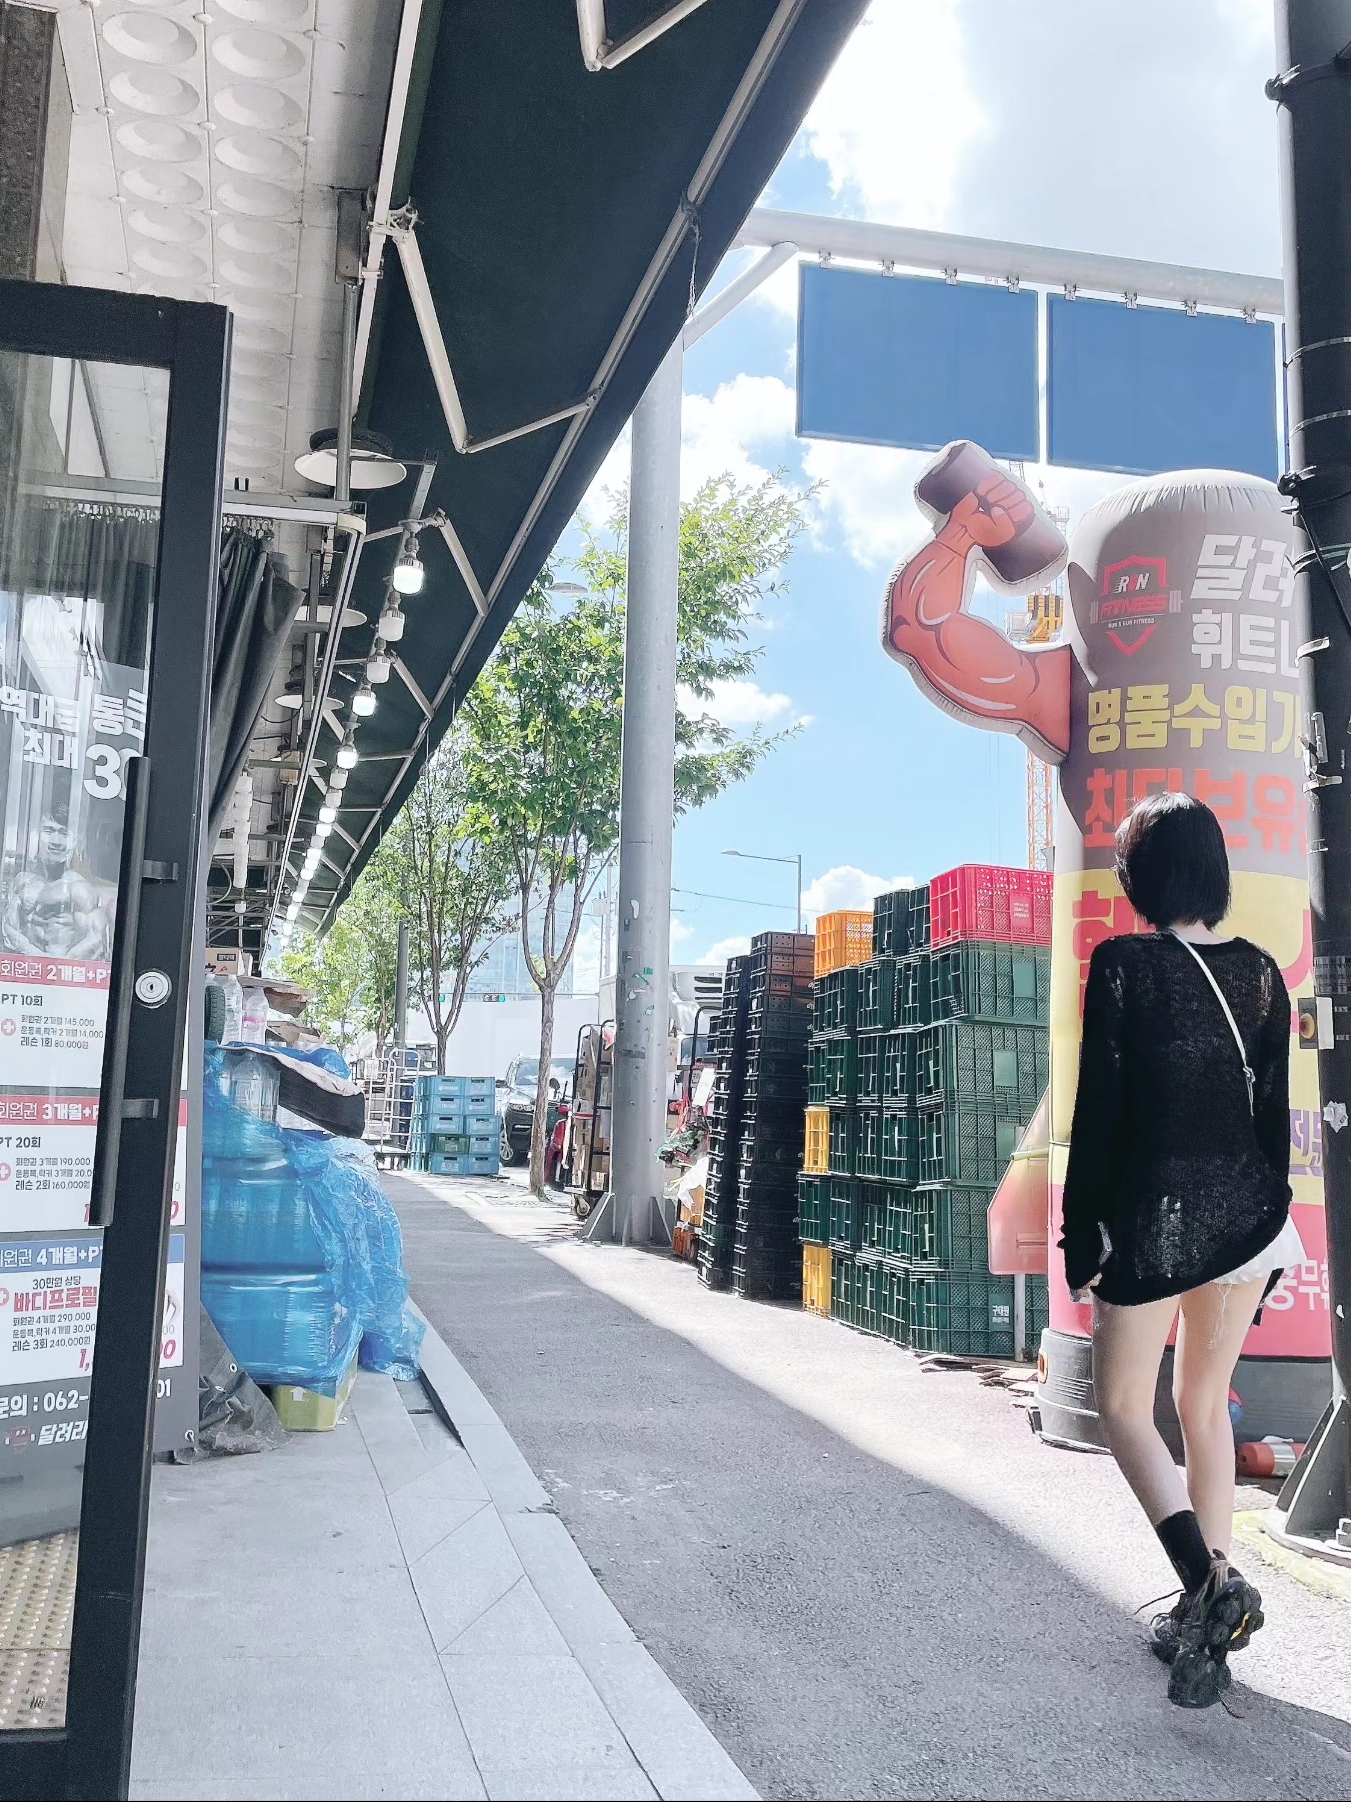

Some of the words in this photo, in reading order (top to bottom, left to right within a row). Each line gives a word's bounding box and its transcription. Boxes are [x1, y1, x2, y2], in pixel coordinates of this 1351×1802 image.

[23, 728, 79, 770] 최대
[1, 960, 42, 979] 회원권
[46, 965, 111, 984] 2개월+P
[1, 993, 18, 1005] PT
[20, 995, 43, 1006] 10회
[20, 1036, 38, 1047] 레슨
[41, 1037, 53, 1048] 1회
[15, 1136, 41, 1148] 20회
[60, 1157, 91, 1166] 190,000
[15, 1179, 34, 1191] 레슨
[35, 1179, 50, 1190] 2회
[36, 1245, 103, 1266] 4개월+P
[32, 1276, 63, 1290] 30만원
[14, 1286, 98, 1313] 바디프로필
[57, 1312, 91, 1323] 290,000
[12, 1339, 31, 1352] 레슨
[33, 1338, 48, 1350] 3회
